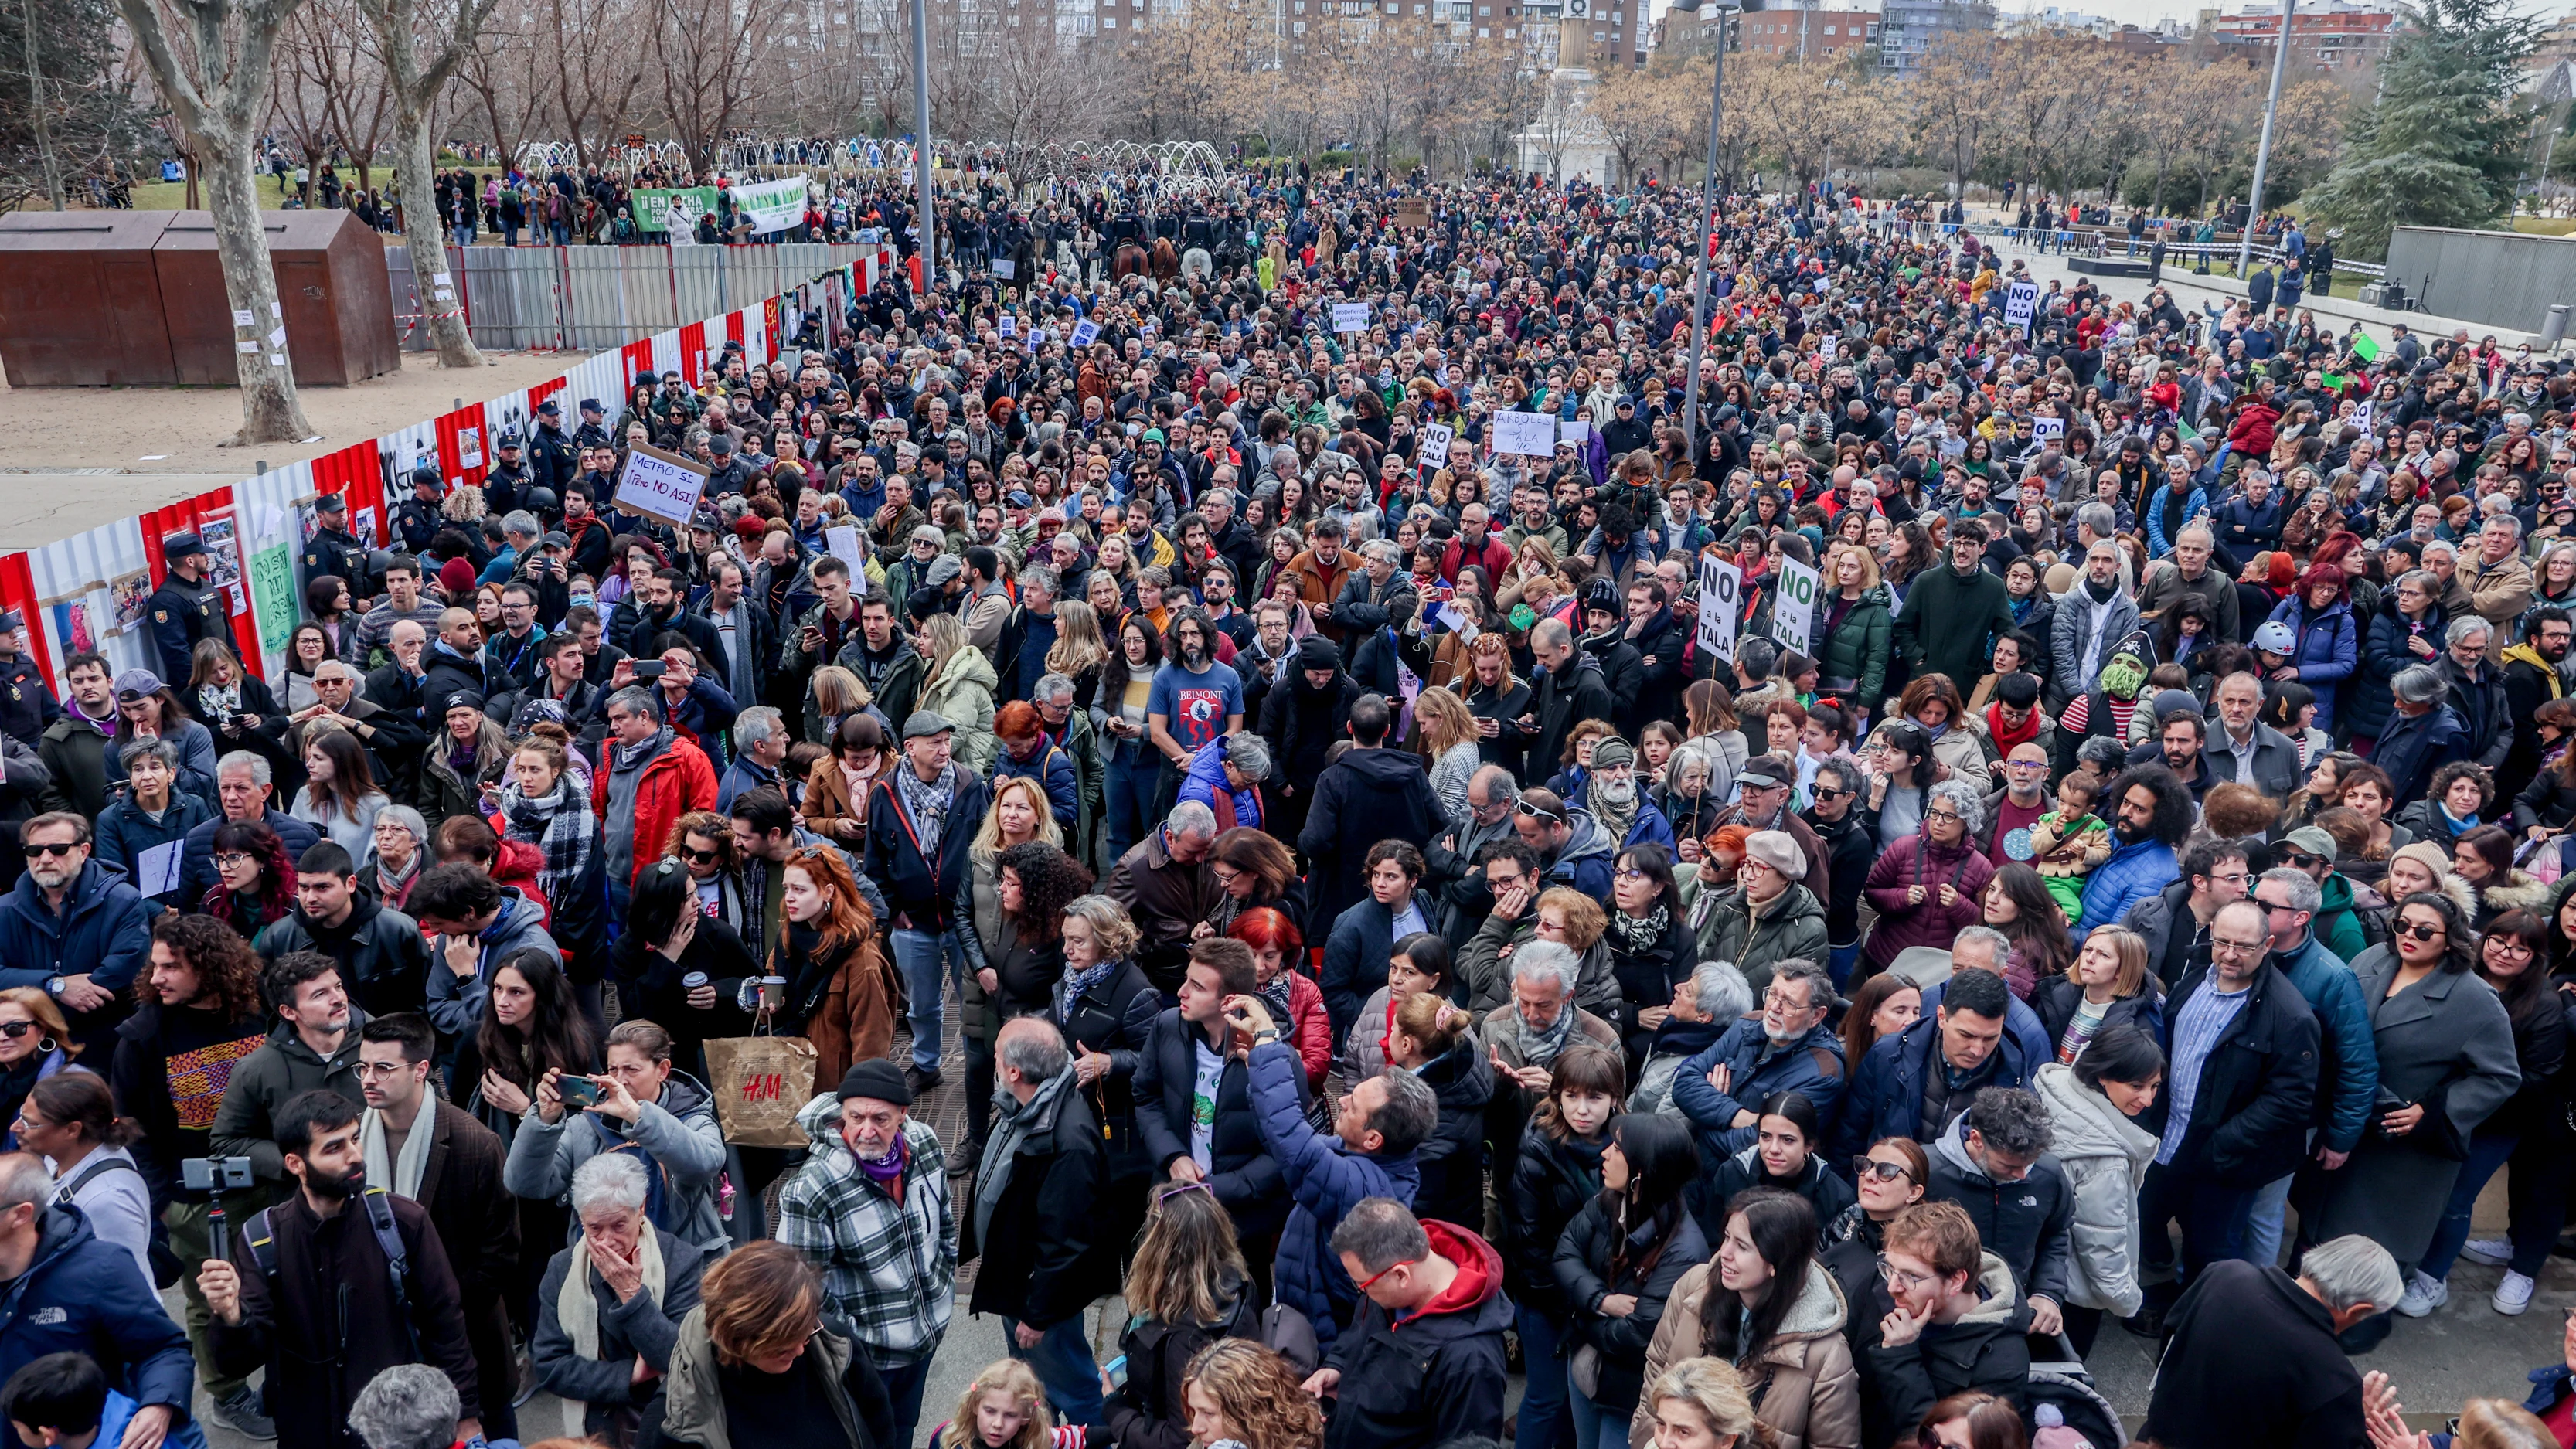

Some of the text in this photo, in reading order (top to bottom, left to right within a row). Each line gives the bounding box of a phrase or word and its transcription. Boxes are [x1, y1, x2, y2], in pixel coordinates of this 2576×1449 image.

[650, 196, 665, 208] EN
[667, 195, 703, 209] LCHA
[767, 206, 783, 214] UNO
[2011, 287, 2034, 301] NO
[2007, 309, 2030, 319] TALA
[1425, 427, 1447, 444] NO
[1509, 434, 1538, 443] TALA
[1514, 442, 1532, 451] NO
[1421, 450, 1442, 463] TALA
[634, 454, 694, 484] METRO SI
[652, 479, 669, 495] NO
[1702, 562, 1734, 604] NO
[1780, 565, 1812, 605] NO
[1707, 610, 1721, 624] a la
[1789, 613, 1797, 625] la
[1700, 622, 1730, 655] TALA
[1775, 620, 1805, 653] TALA
[1178, 690, 1223, 701] BELMONT
[144, 853, 158, 868] NO
[742, 1073, 781, 1102] H&M
[34, 1318, 55, 1326] FACE
